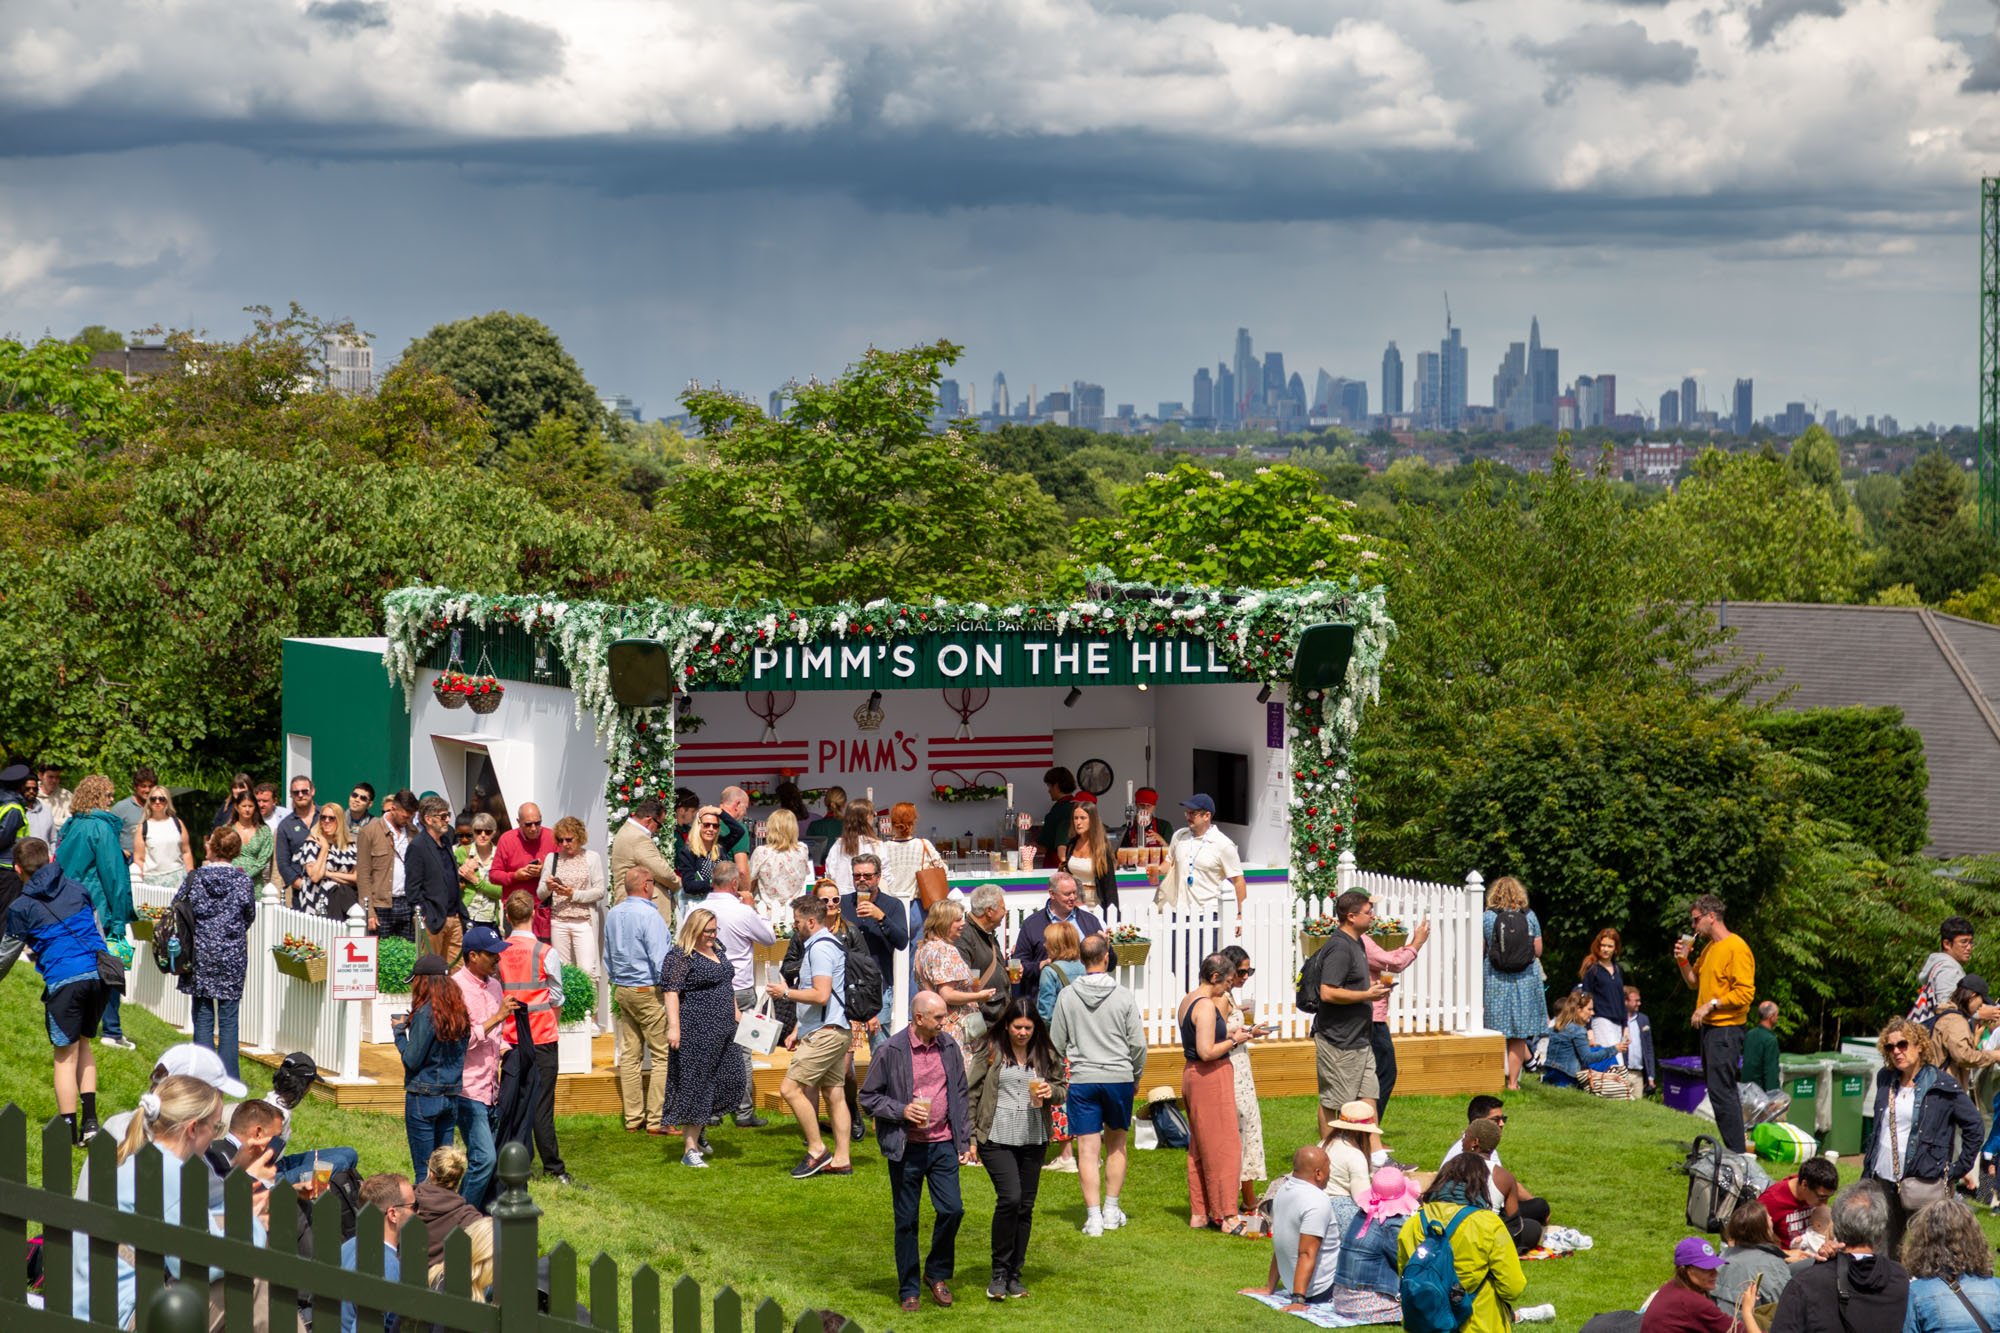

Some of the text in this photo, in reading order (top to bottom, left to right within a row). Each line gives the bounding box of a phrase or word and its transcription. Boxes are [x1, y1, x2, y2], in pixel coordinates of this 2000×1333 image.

[754, 641, 1229, 678] PIMM’S ON THE HILL
[818, 730, 918, 774] PIMM’S
